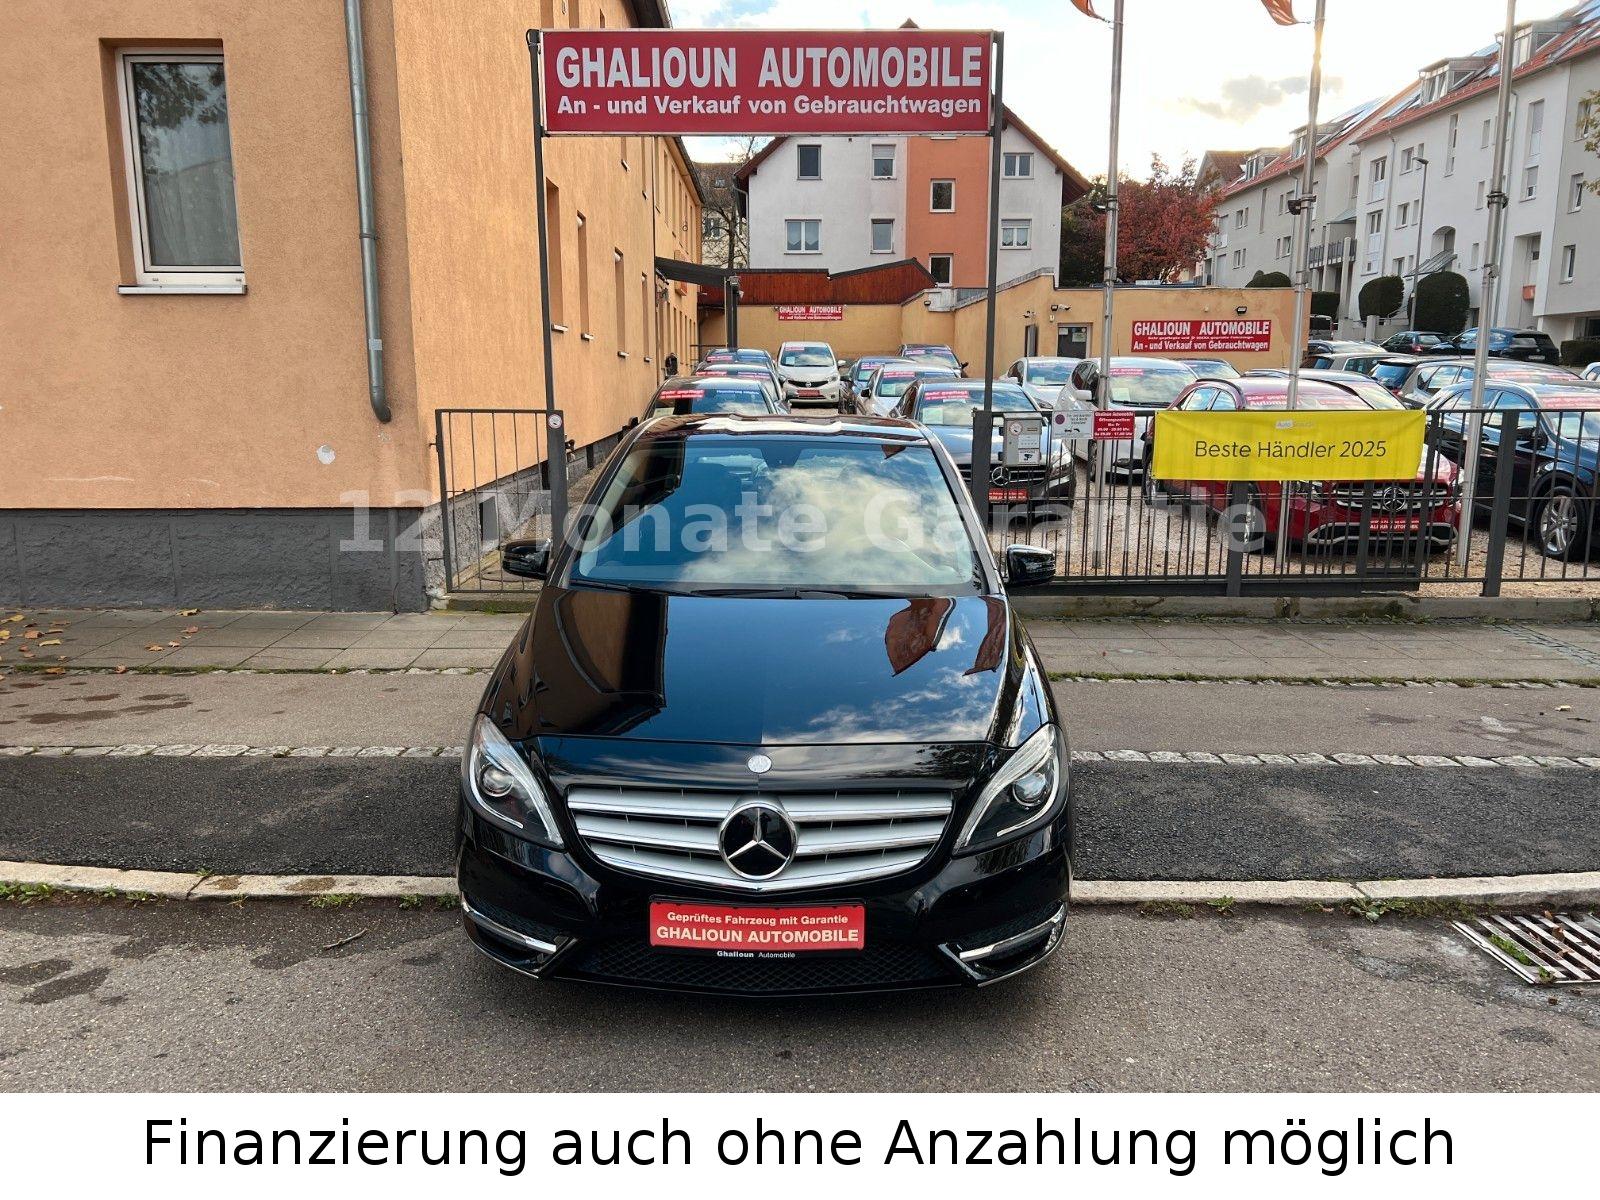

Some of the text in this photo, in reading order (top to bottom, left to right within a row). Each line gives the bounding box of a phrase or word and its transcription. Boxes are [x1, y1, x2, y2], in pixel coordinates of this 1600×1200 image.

[556, 46, 982, 88] GHALIOUN AUTOMOBILE
[557, 95, 587, 114] An
[606, 95, 647, 114] und
[653, 95, 741, 114] Verkauf
[748, 98, 787, 114] von
[793, 95, 981, 117] Gebrauchtwagen
[1134, 321, 1270, 336] GHALIOUN AUTOMOBILE
[1133, 342, 1143, 350] An
[1149, 341, 1163, 350] und
[1164, 341, 1193, 350] Verkauf
[1193, 342, 1207, 350] von
[1208, 340, 1268, 351] Gebrauchtwagen
[1195, 440, 1387, 458] Beste Händler 2025
[667, 911, 848, 926] Geprüftes Fahrzeug mit Garantie
[656, 926, 859, 943] GHALIOUN AUTOMOBILE
[717, 950, 796, 959] Ghalioun Automobile
